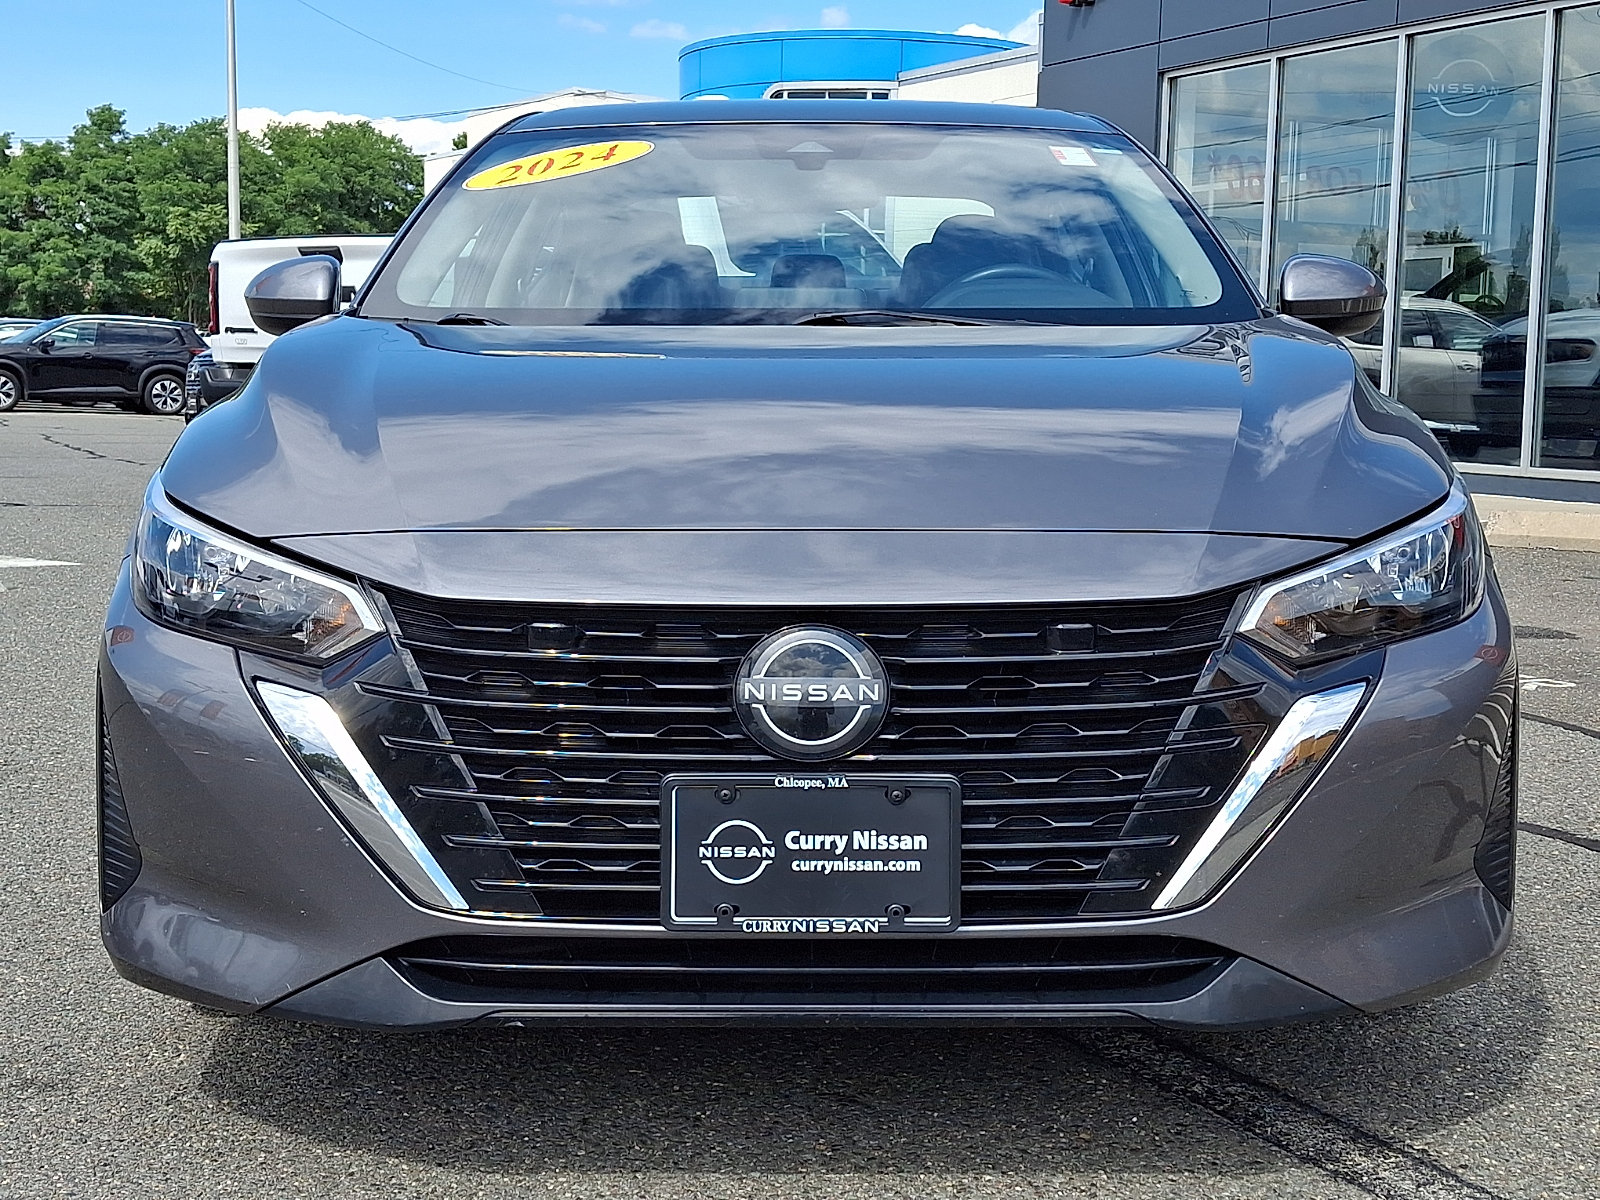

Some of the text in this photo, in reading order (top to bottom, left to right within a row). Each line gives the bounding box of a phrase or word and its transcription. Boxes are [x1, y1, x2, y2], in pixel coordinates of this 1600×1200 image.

[1428, 83, 1500, 96] NISSAN
[496, 144, 619, 185] 2024
[743, 682, 880, 702] NISSAN
[774, 775, 849, 790] Chicopee, MA
[784, 830, 928, 855] Curry Nissan
[698, 846, 776, 859] NISSAN
[791, 857, 922, 875] currynissan.com
